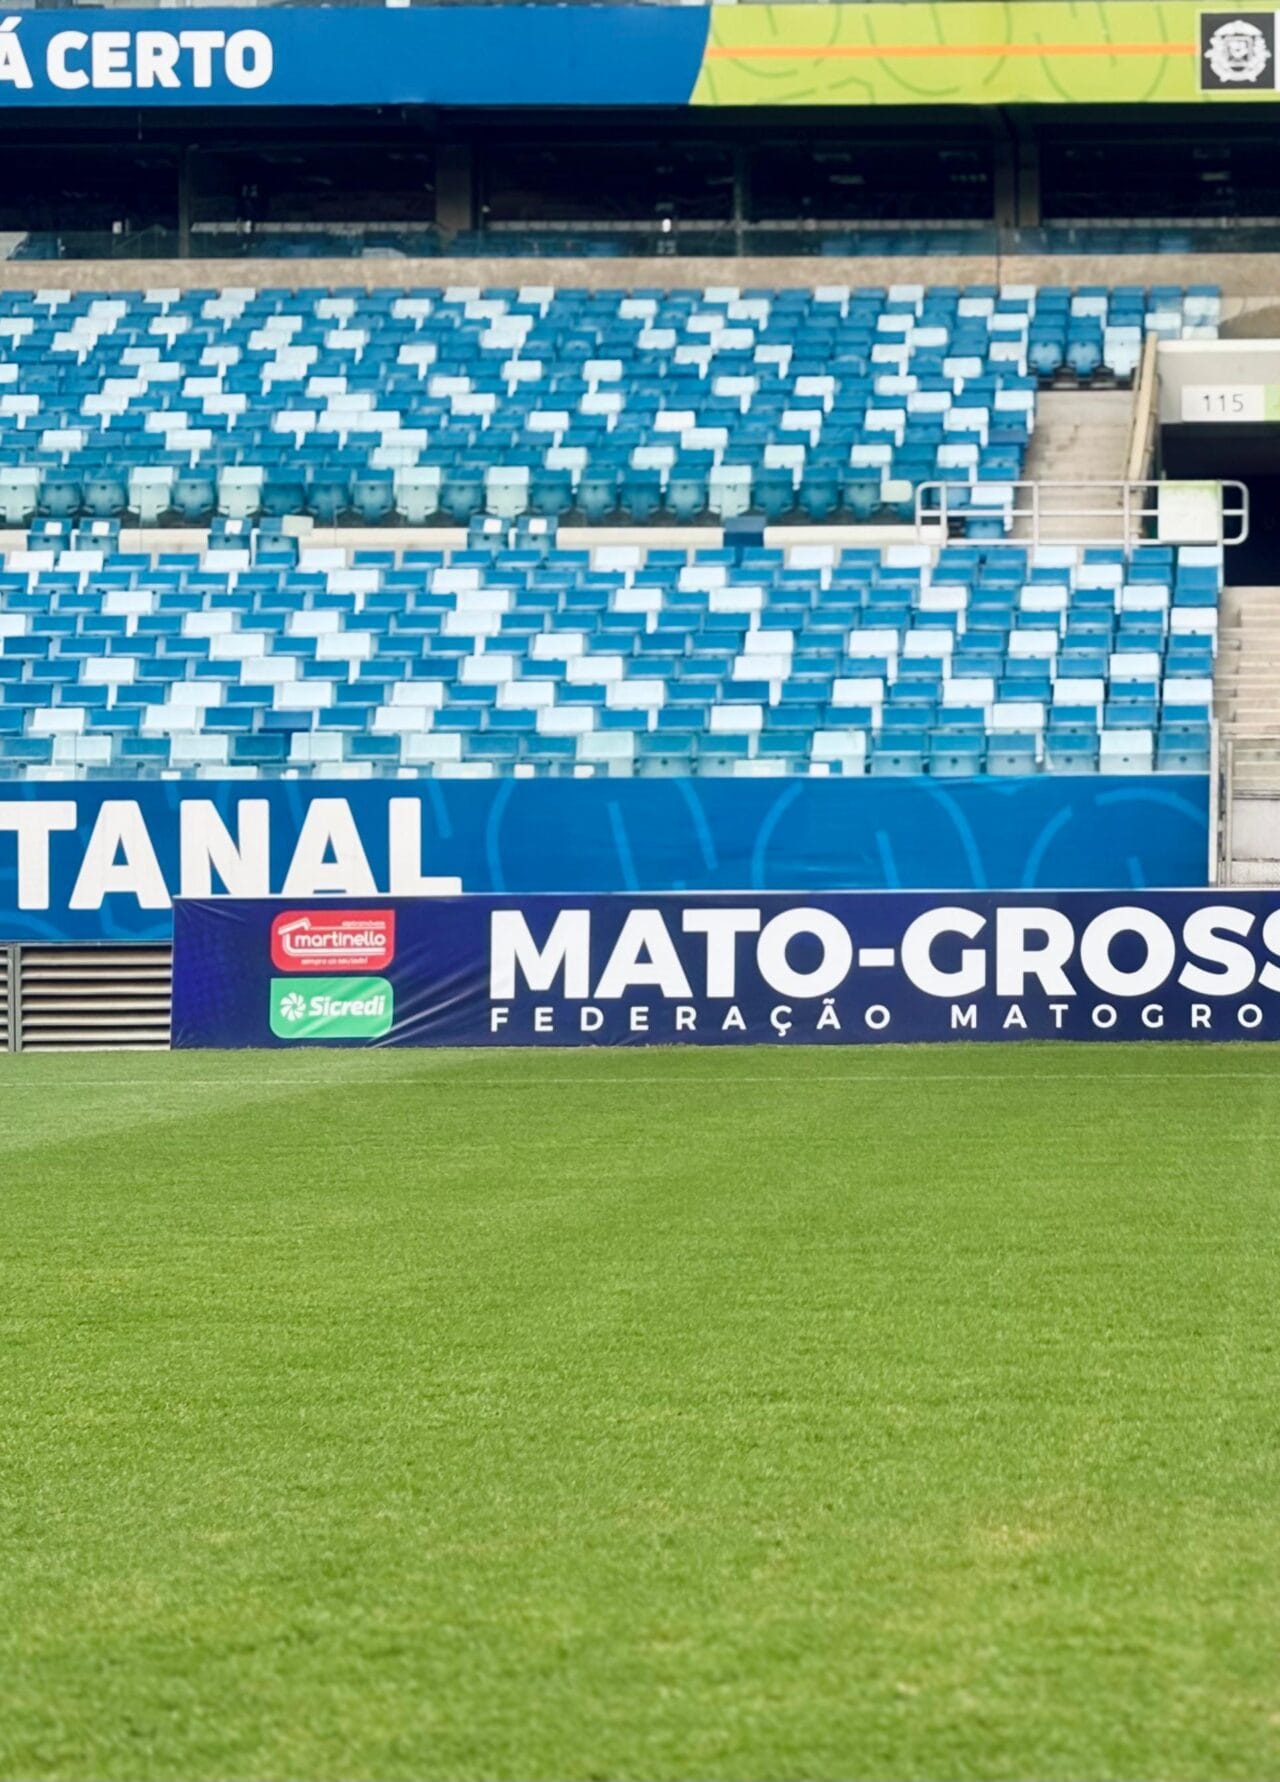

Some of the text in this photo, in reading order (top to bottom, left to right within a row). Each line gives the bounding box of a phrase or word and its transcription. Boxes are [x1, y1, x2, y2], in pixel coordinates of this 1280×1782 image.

[46, 30, 273, 89] CERTO
[1203, 394, 1244, 413] 115
[0, 798, 462, 910] TANAL
[294, 931, 387, 947] martinello
[308, 994, 387, 1017] Sicredi
[490, 998, 892, 1037] FEDERAÇÃO
